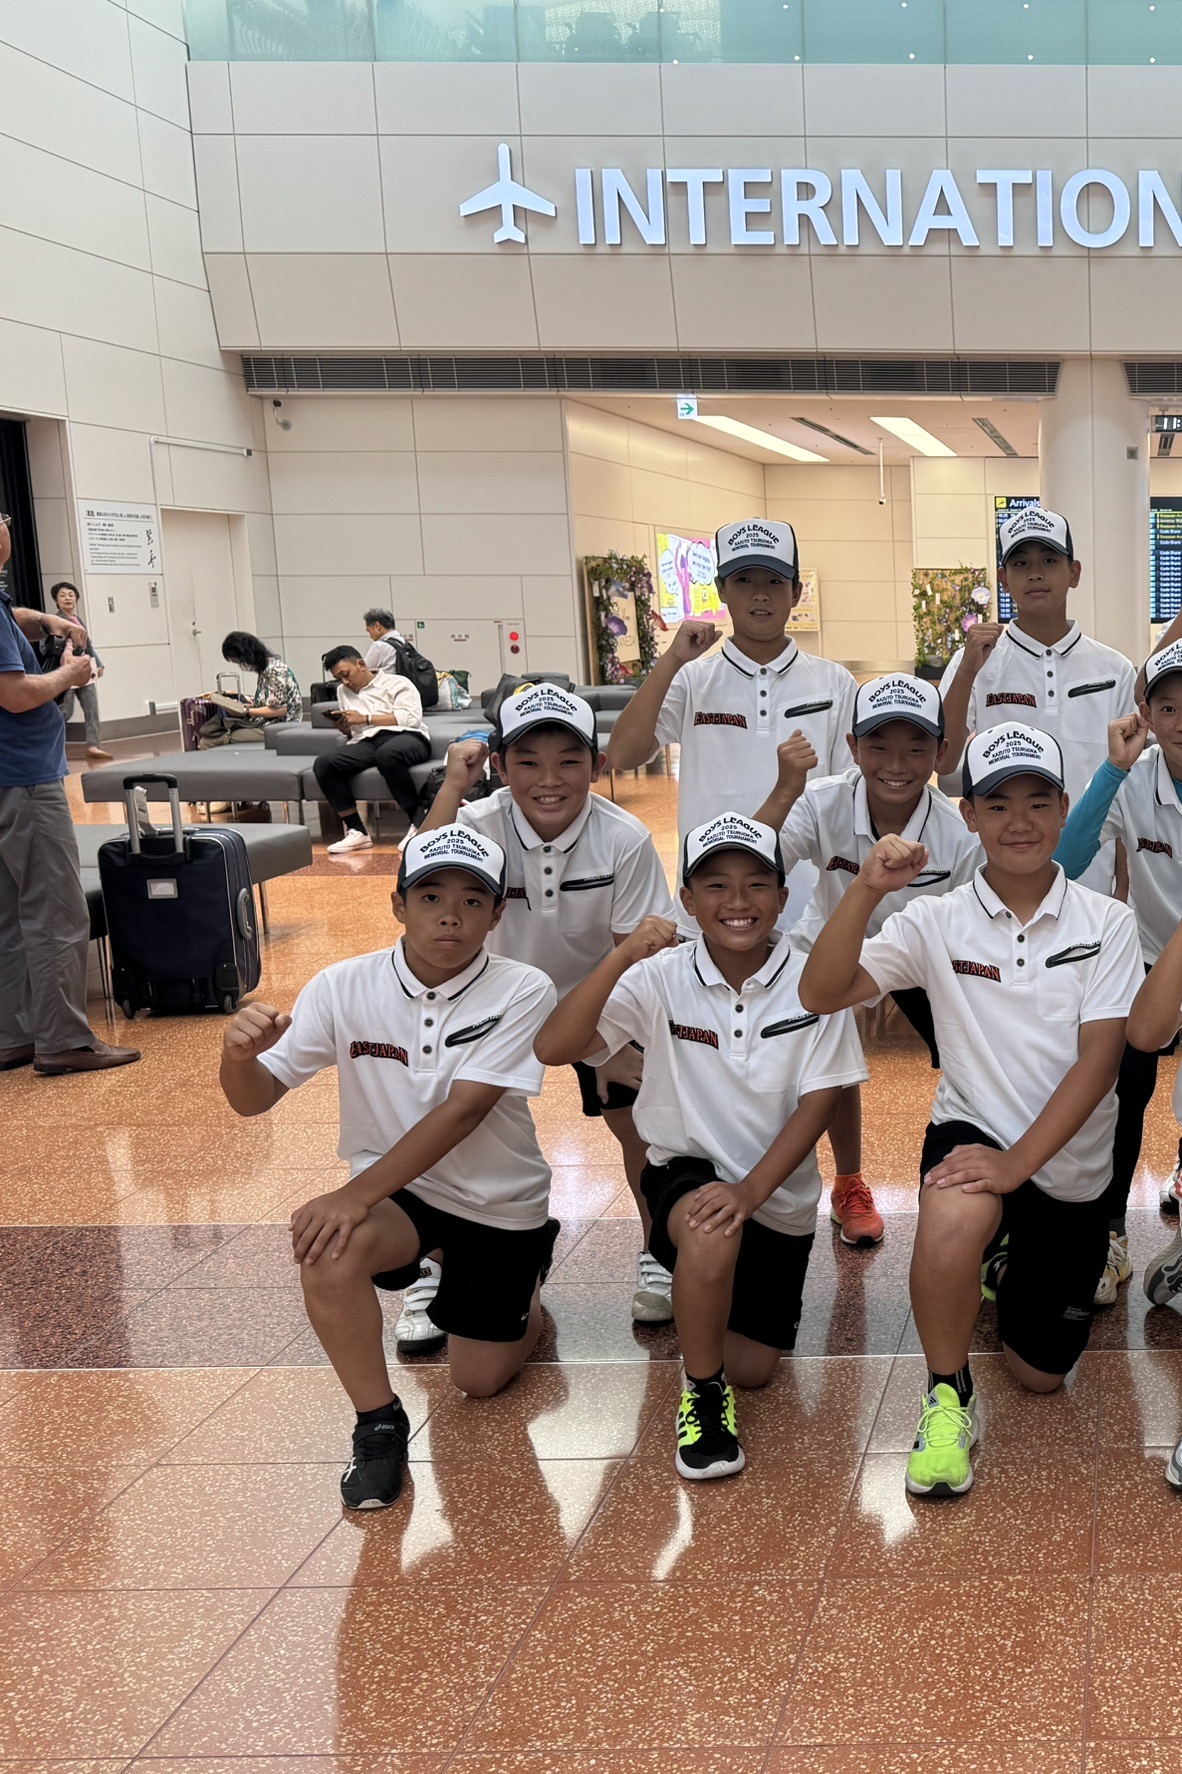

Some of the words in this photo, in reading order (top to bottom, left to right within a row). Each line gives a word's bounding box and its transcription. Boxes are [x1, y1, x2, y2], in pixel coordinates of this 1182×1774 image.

[1009, 499, 1040, 508] Arrivals
[1008, 515, 1024, 533] BOYS
[1025, 511, 1055, 528] LEAGUE
[728, 527, 746, 546] BOYS
[748, 524, 779, 544] LEAGUE
[1155, 646, 1175, 666] BOYS
[515, 692, 539, 711] BOYS
[541, 689, 577, 711] LEAGUE
[869, 682, 890, 703] BOYS
[892, 680, 926, 703] LEAGUE
[983, 735, 1005, 758] BOYS
[1007, 731, 1044, 753] LEAGUE
[699, 820, 721, 842] BOYS
[724, 817, 762, 839] LEAGUE
[420, 832, 447, 853] BOYS
[450, 830, 489, 858] LEAGUE
[350, 1041, 409, 1067] EASTJAPAN
